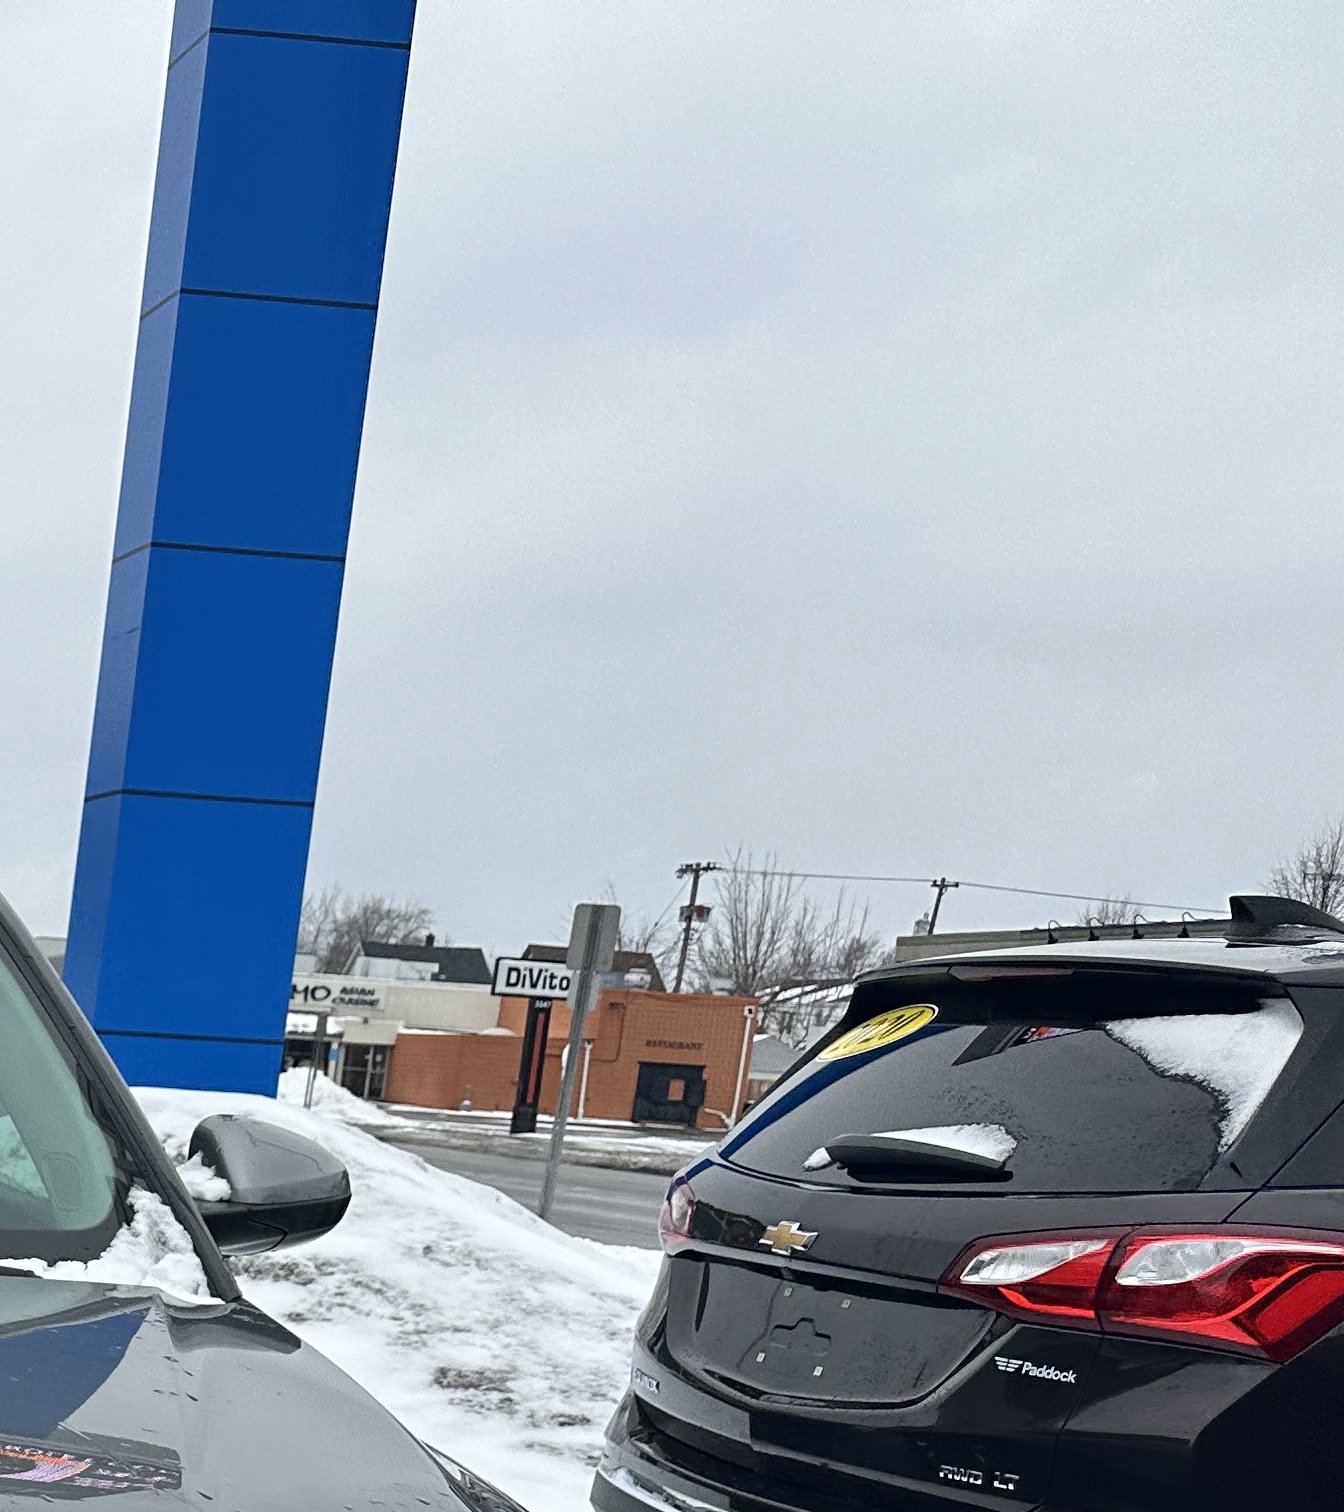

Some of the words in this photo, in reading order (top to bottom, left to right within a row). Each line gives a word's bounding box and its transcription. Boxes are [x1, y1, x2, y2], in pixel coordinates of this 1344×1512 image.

[340, 986, 375, 996] ASIAN
[505, 966, 570, 991] DiVito
[824, 1009, 927, 1055] 2020
[1021, 1361, 1077, 1384] Paddock
[939, 1464, 983, 1485] AWD
[993, 1471, 1020, 1491] LT
